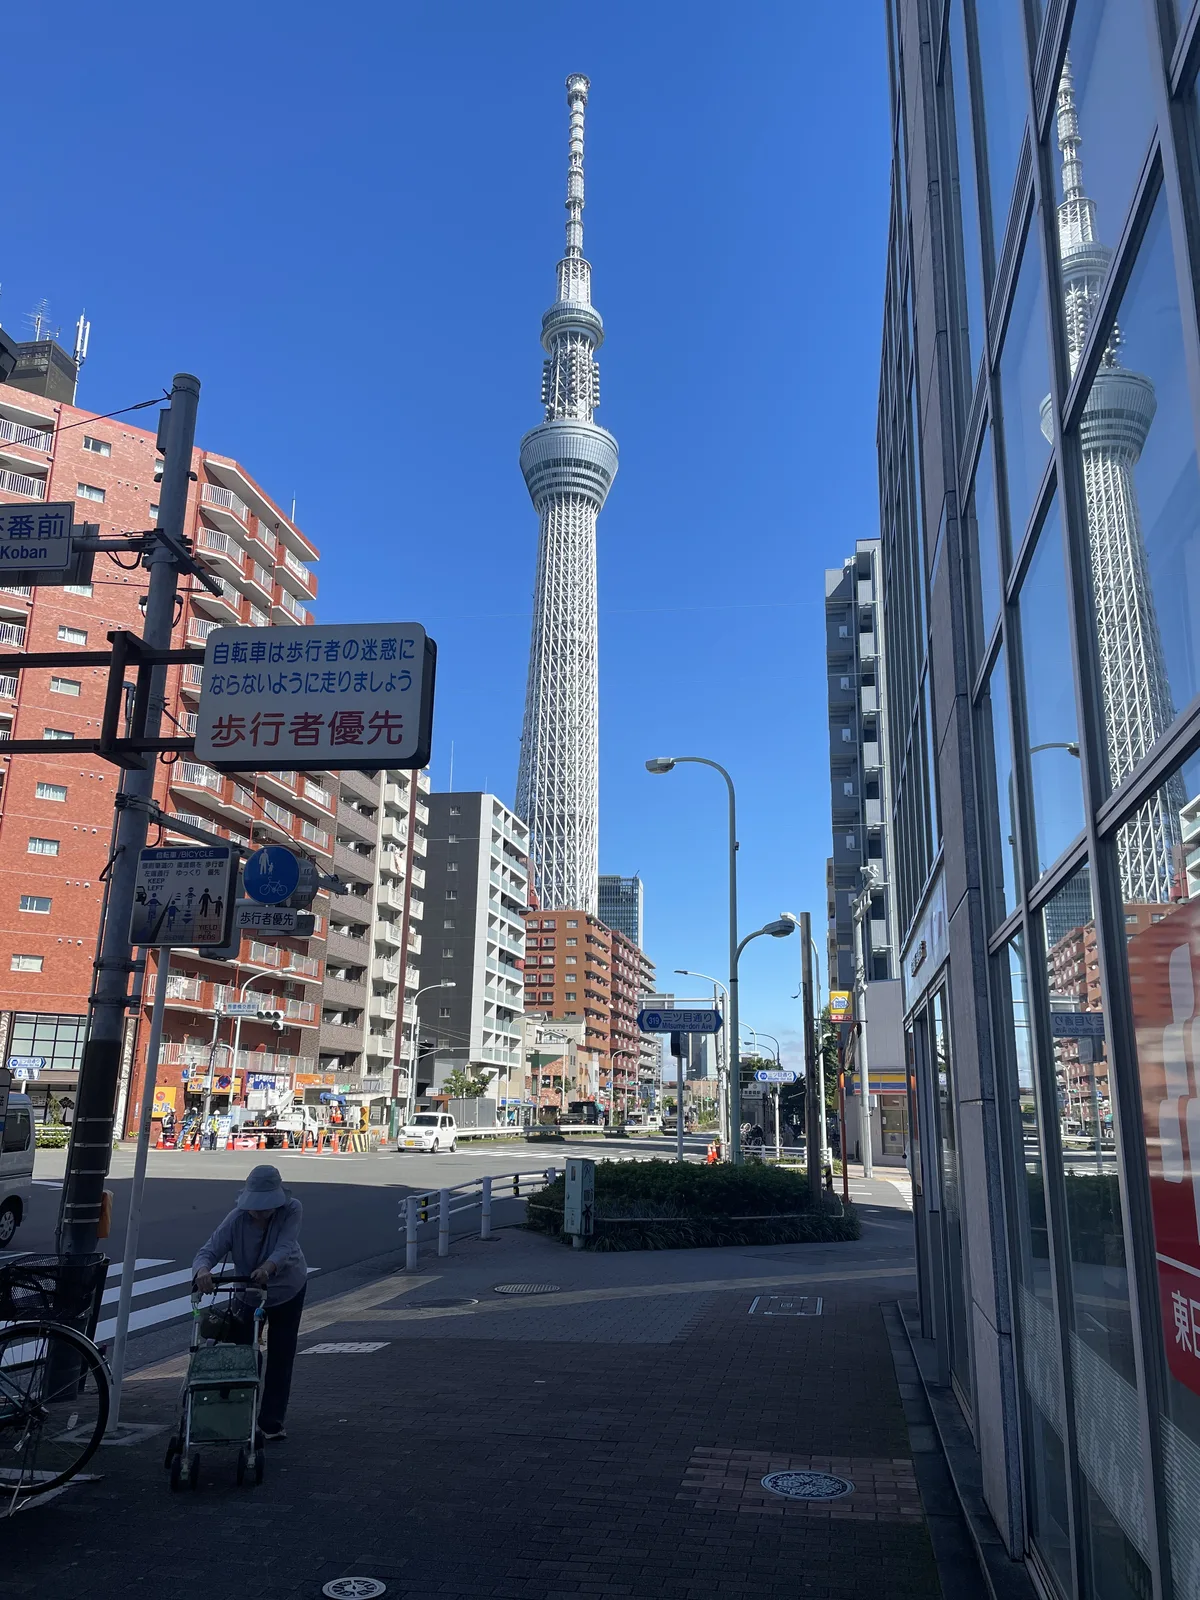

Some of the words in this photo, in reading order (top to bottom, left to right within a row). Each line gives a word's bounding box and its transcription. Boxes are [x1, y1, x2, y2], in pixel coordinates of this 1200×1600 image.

[0, 512, 66, 541] 番前
[0, 545, 48, 560] Koban
[212, 637, 416, 665] 自転車は歩行者の迷惑に
[208, 669, 413, 696] ならないように走りましょう
[210, 708, 405, 748] 歩行者優先
[175, 869, 201, 877] ゆっくり
[240, 912, 294, 927] 歩行者優先
[648, 1016, 660, 1025] 319
[663, 1012, 712, 1023] 三ツ目通り
